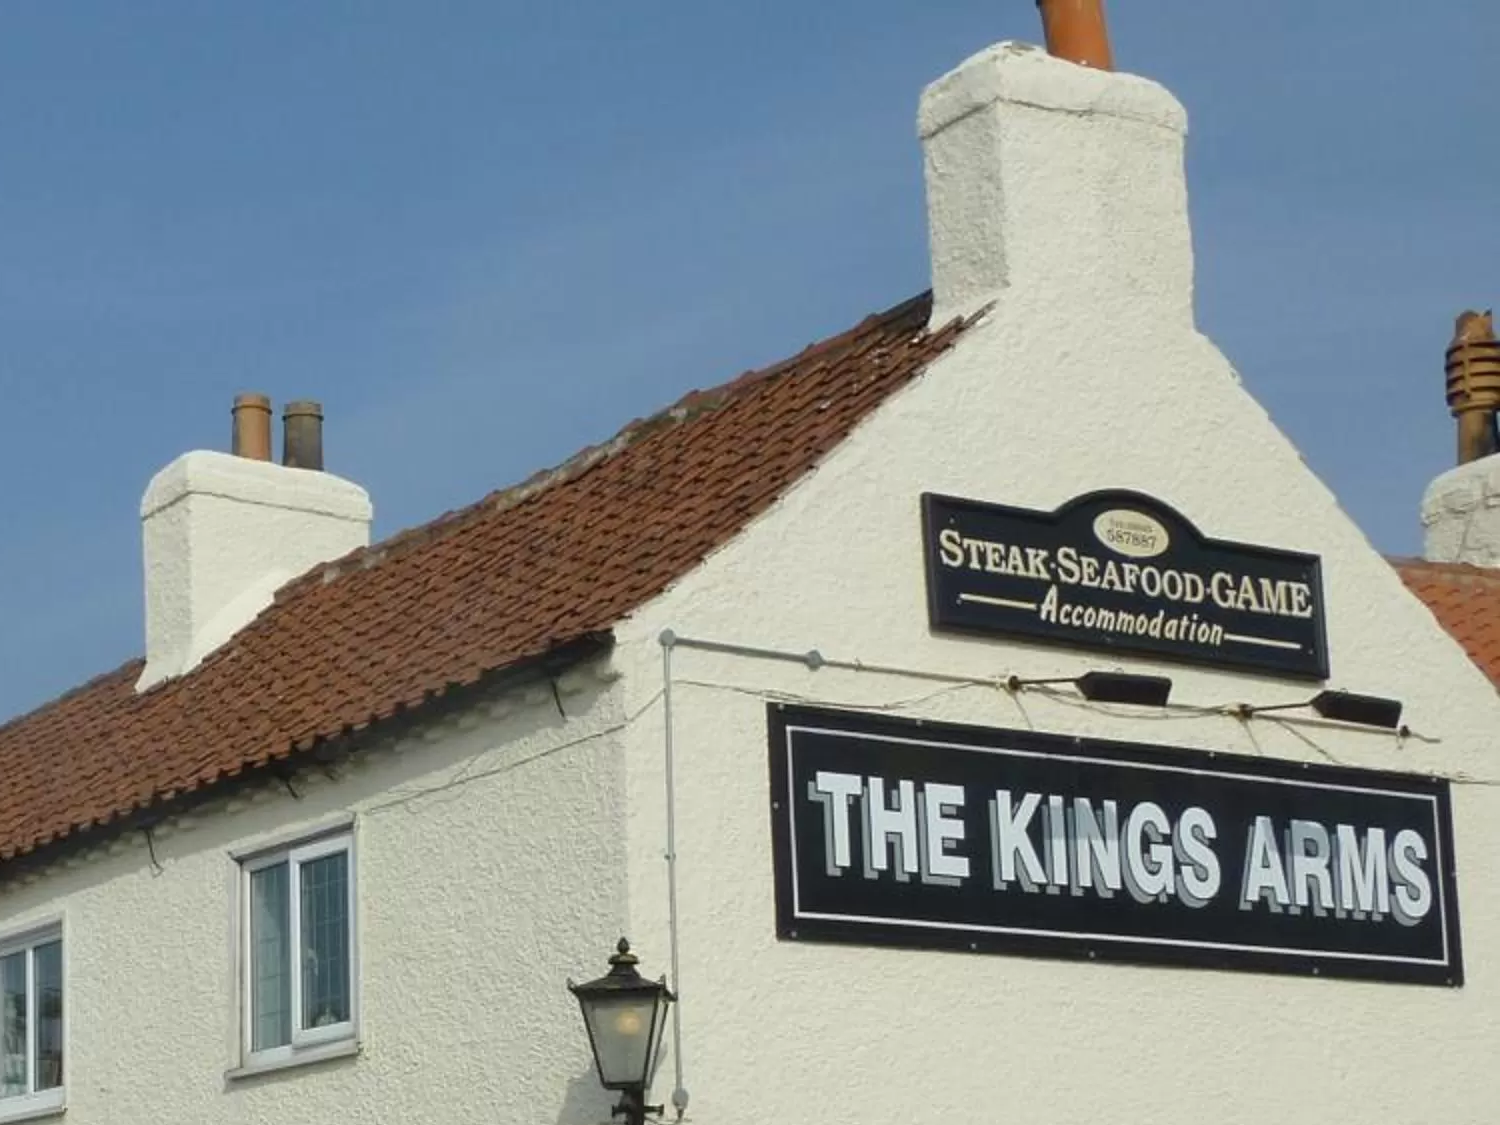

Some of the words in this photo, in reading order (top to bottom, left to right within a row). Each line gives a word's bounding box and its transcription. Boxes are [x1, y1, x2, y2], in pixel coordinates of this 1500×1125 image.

[1039, 585, 1223, 646] Accommodation
[808, 770, 970, 886] THE
[989, 789, 1221, 906] KINGS
[1238, 815, 1434, 925] ARMS
